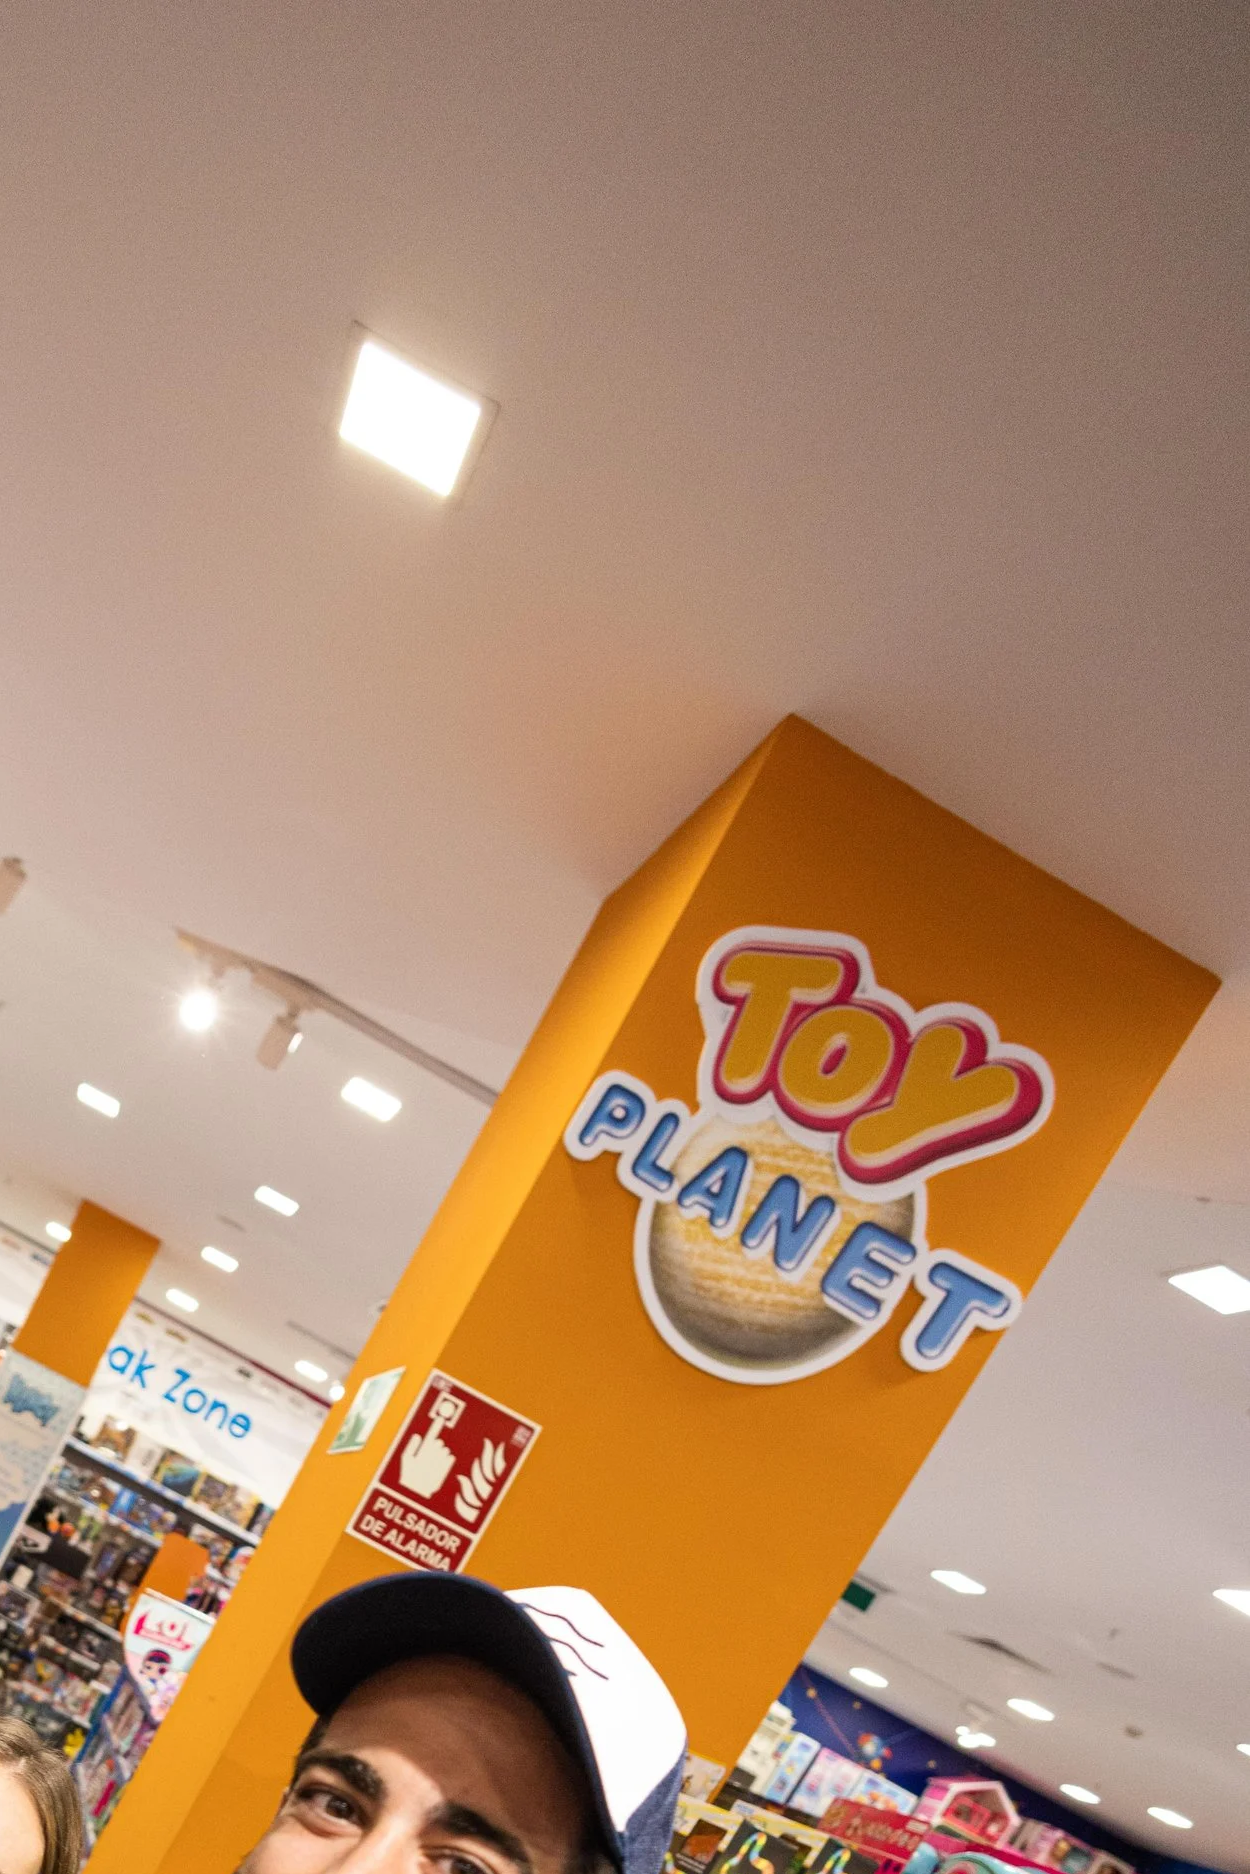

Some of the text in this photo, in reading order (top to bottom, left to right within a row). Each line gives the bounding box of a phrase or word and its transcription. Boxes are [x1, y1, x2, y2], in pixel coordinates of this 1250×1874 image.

[710, 940, 1043, 1185] TOY
[577, 1081, 1012, 1362] PLANET
[162, 1367, 252, 1439] Zone
[359, 1513, 452, 1571] DE ALARMA
[372, 1496, 462, 1554] PULSADOR
